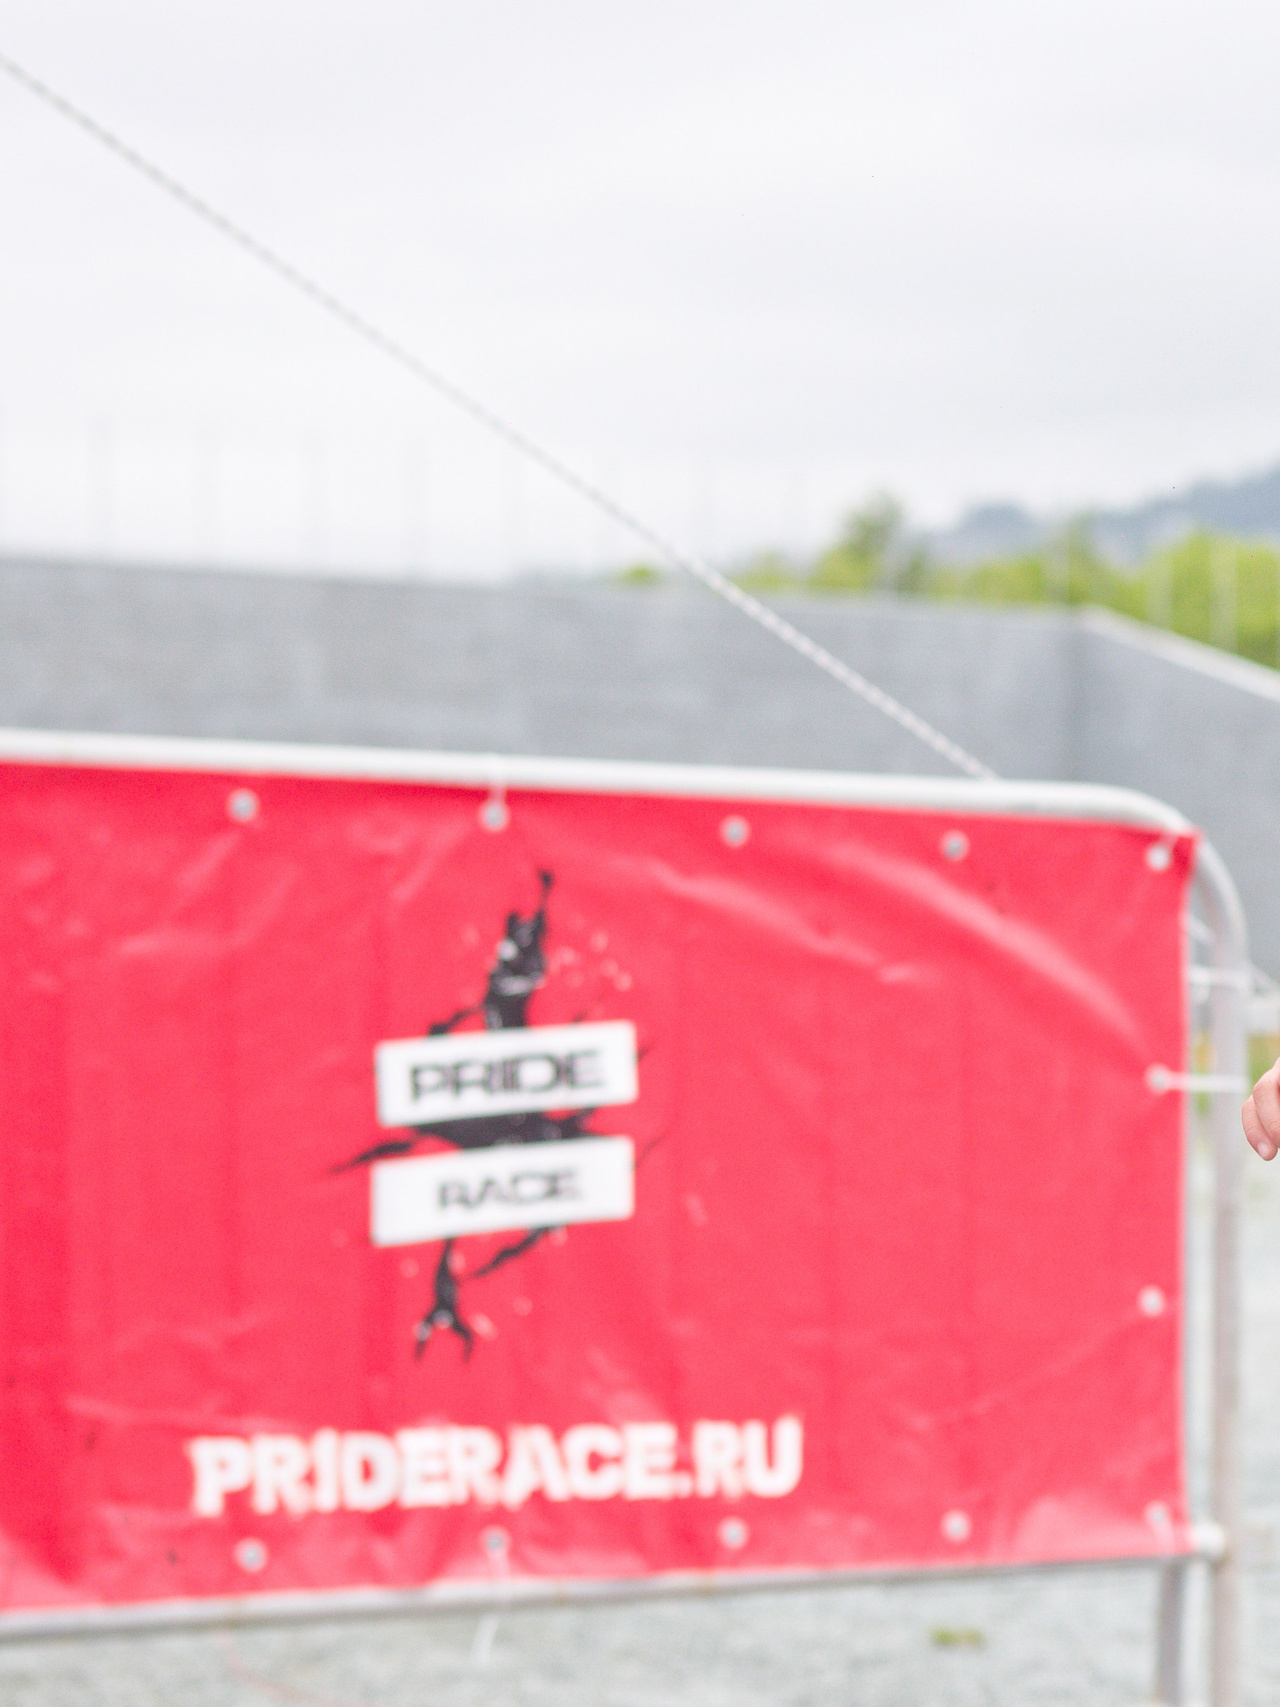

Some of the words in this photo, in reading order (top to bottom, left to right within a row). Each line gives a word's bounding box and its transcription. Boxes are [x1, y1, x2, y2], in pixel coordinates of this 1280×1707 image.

[408, 1048, 606, 1105] PRIDE
[437, 1166, 584, 1215] RACE
[189, 1416, 804, 1517] PRIDERACE.RU
